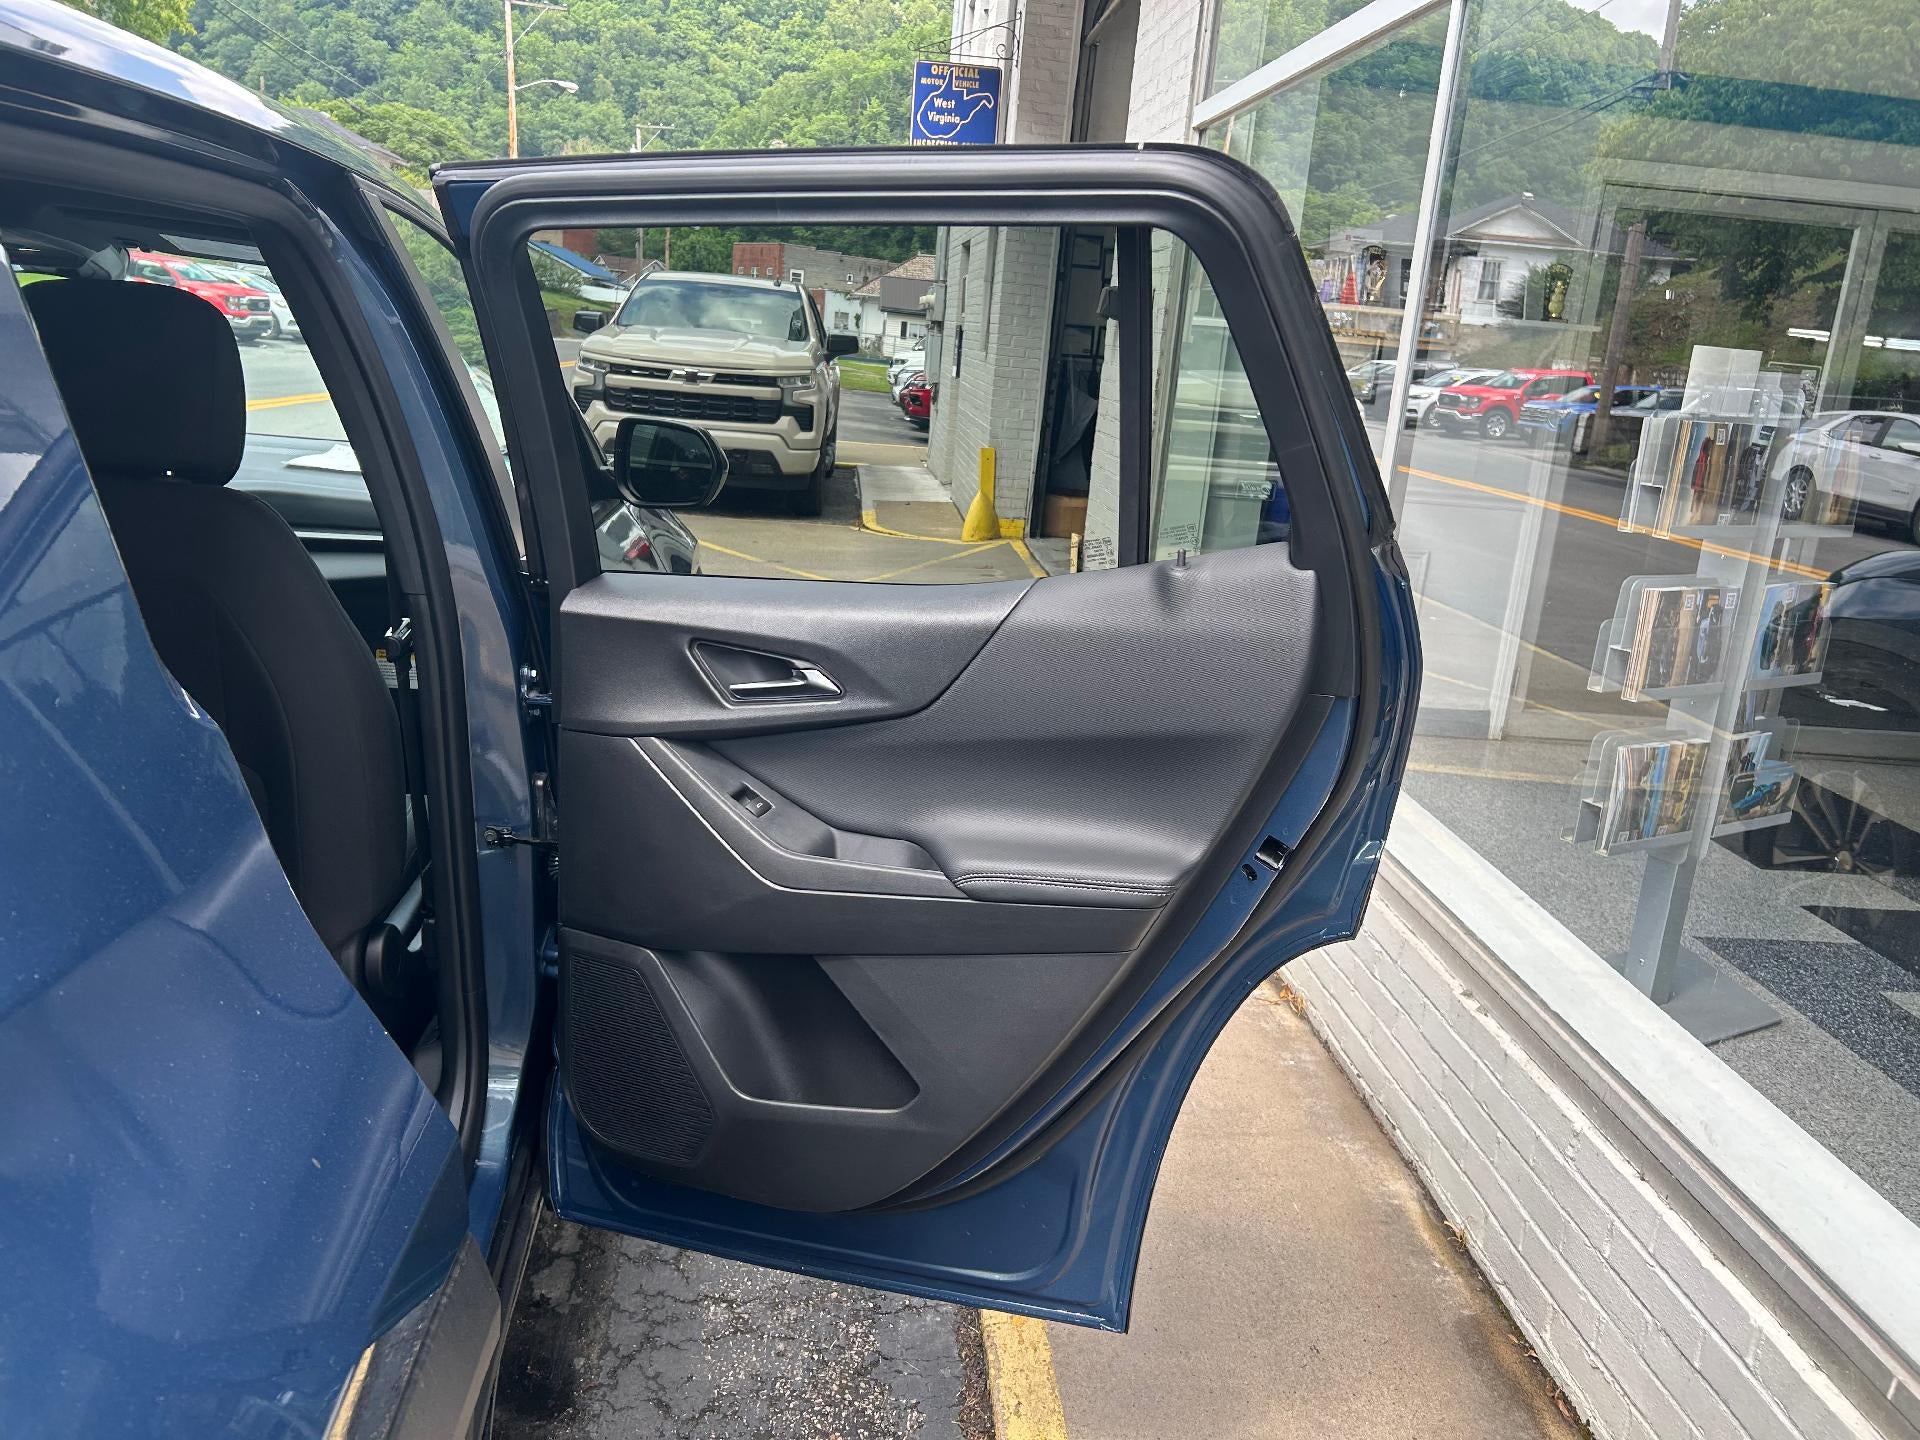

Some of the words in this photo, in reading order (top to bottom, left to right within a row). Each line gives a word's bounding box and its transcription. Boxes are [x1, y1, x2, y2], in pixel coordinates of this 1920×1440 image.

[931, 64, 980, 78] OFFICIAL
[921, 77, 944, 85] MOTOR
[955, 80, 979, 89] VEHICLE
[934, 97, 955, 109] West
[927, 111, 960, 125] Virginia
